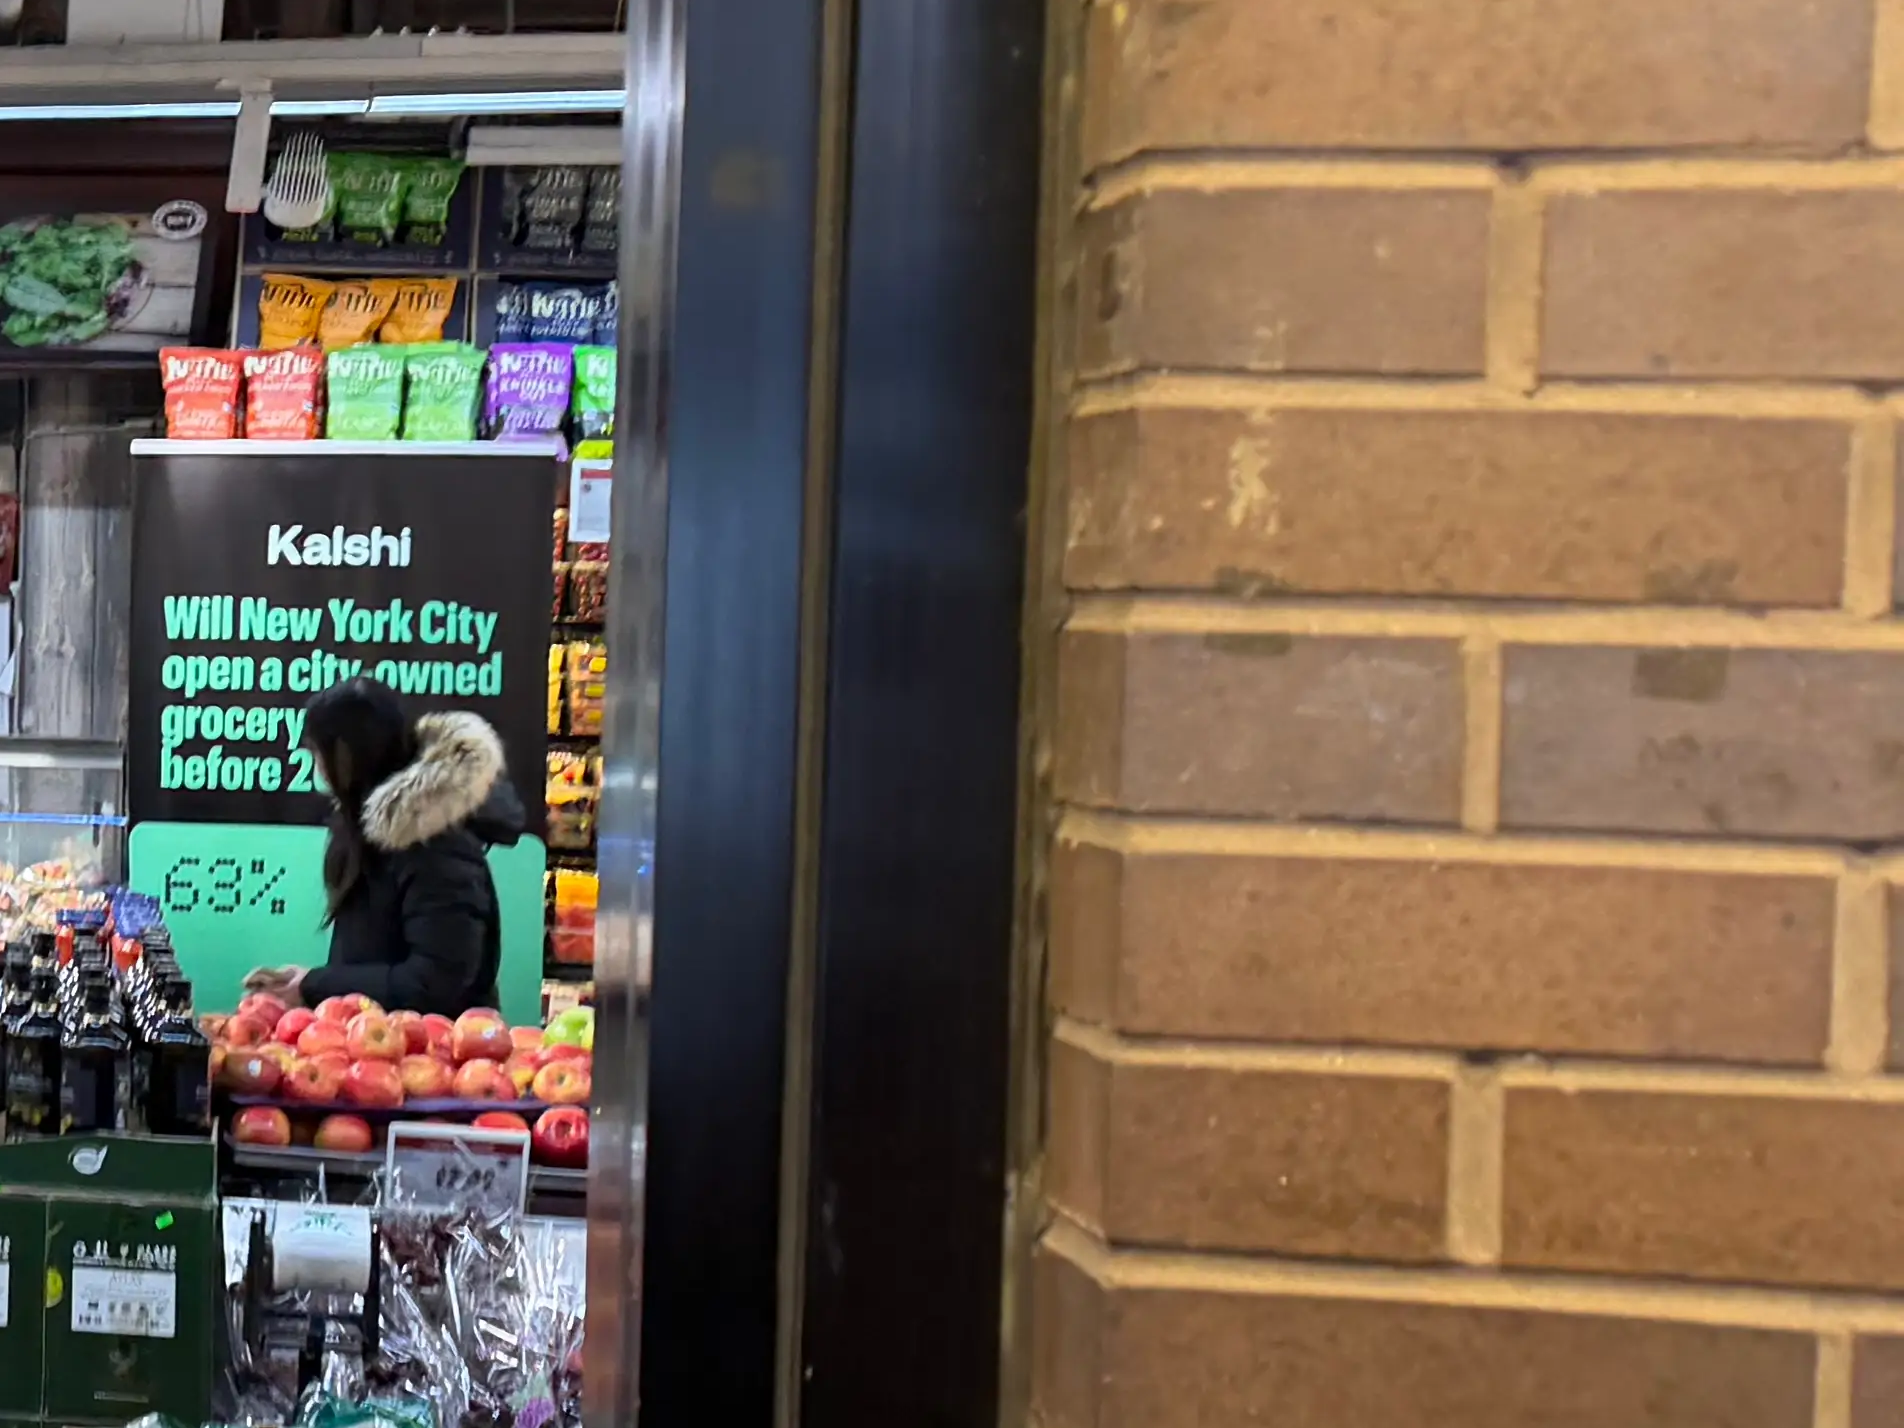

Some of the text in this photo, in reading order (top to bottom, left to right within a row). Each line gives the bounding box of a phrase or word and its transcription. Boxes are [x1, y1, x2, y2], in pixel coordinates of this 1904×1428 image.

[268, 525, 412, 567] Kalshi
[164, 595, 498, 654] Will New York City
[161, 654, 254, 698] open
[261, 657, 282, 692] a
[161, 703, 307, 750] grocery
[161, 741, 281, 791] before
[165, 858, 286, 913] 63%
